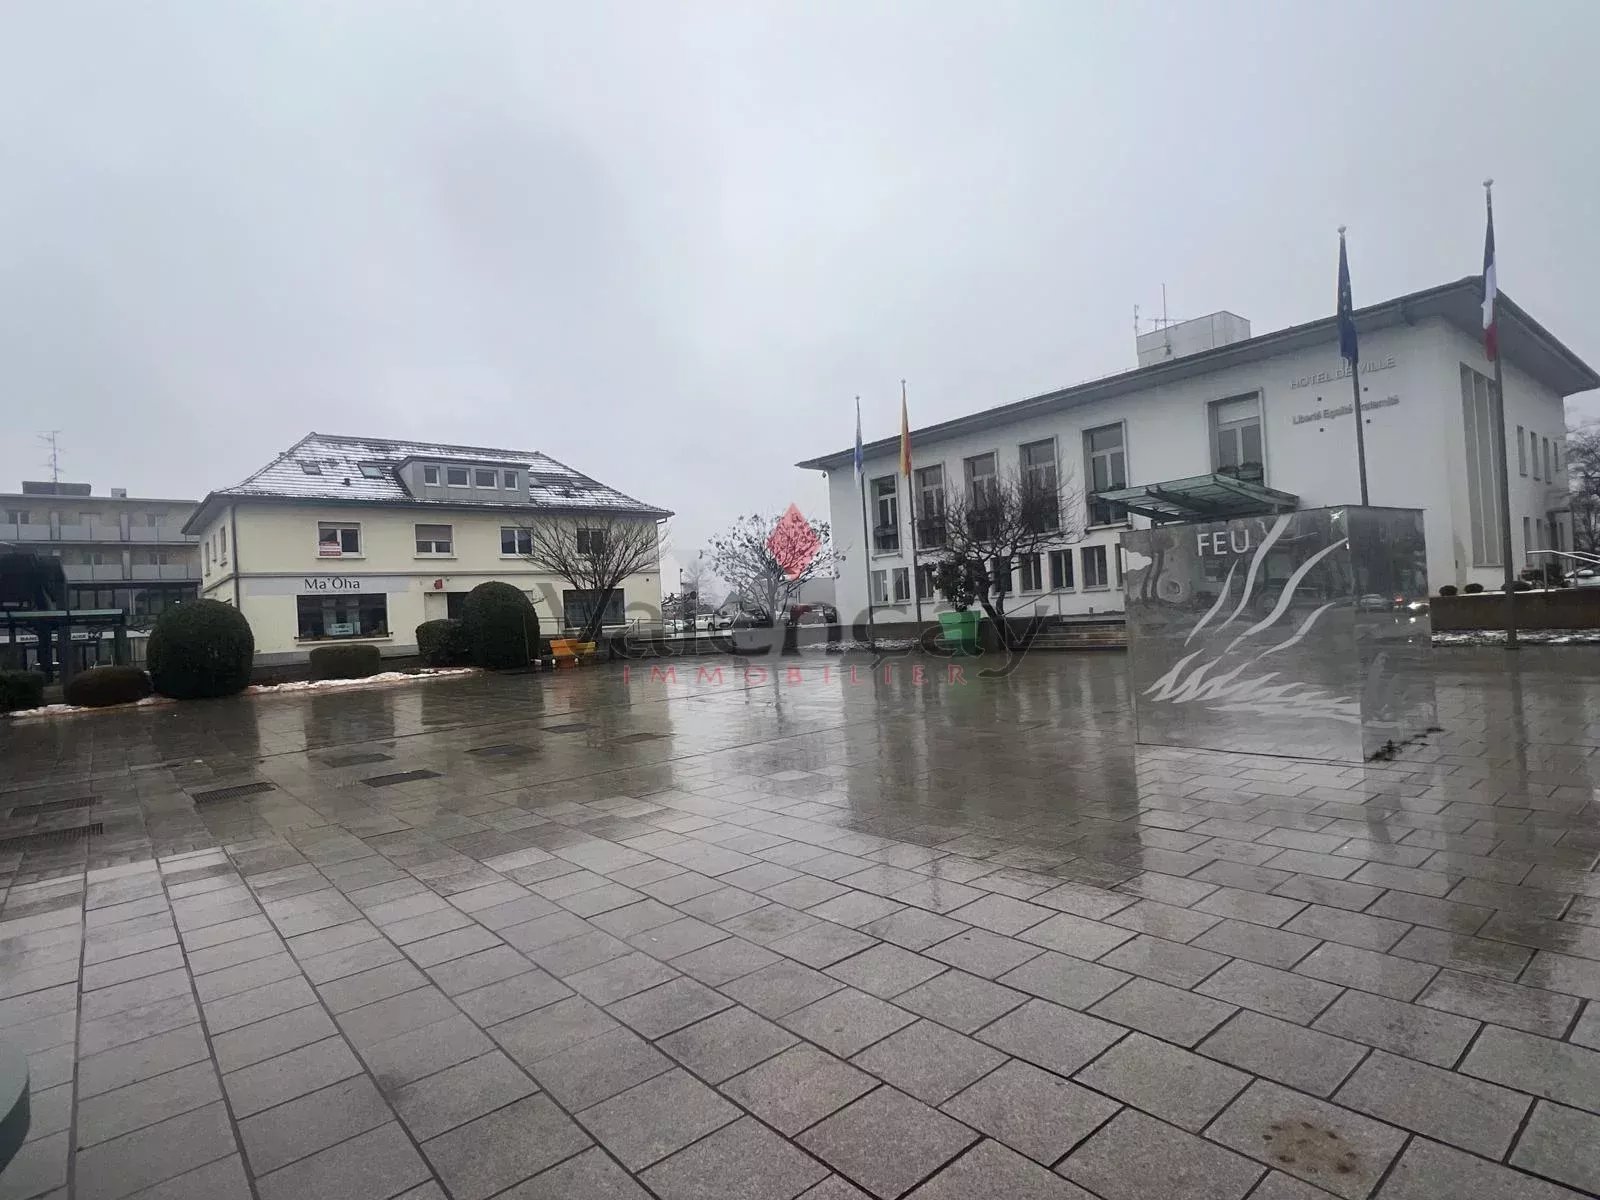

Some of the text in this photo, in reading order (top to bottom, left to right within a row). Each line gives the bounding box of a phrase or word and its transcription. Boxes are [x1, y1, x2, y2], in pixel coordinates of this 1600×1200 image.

[1336, 366, 1353, 379] DE
[1359, 357, 1396, 374] VILLE
[1197, 529, 1250, 557] FEU
